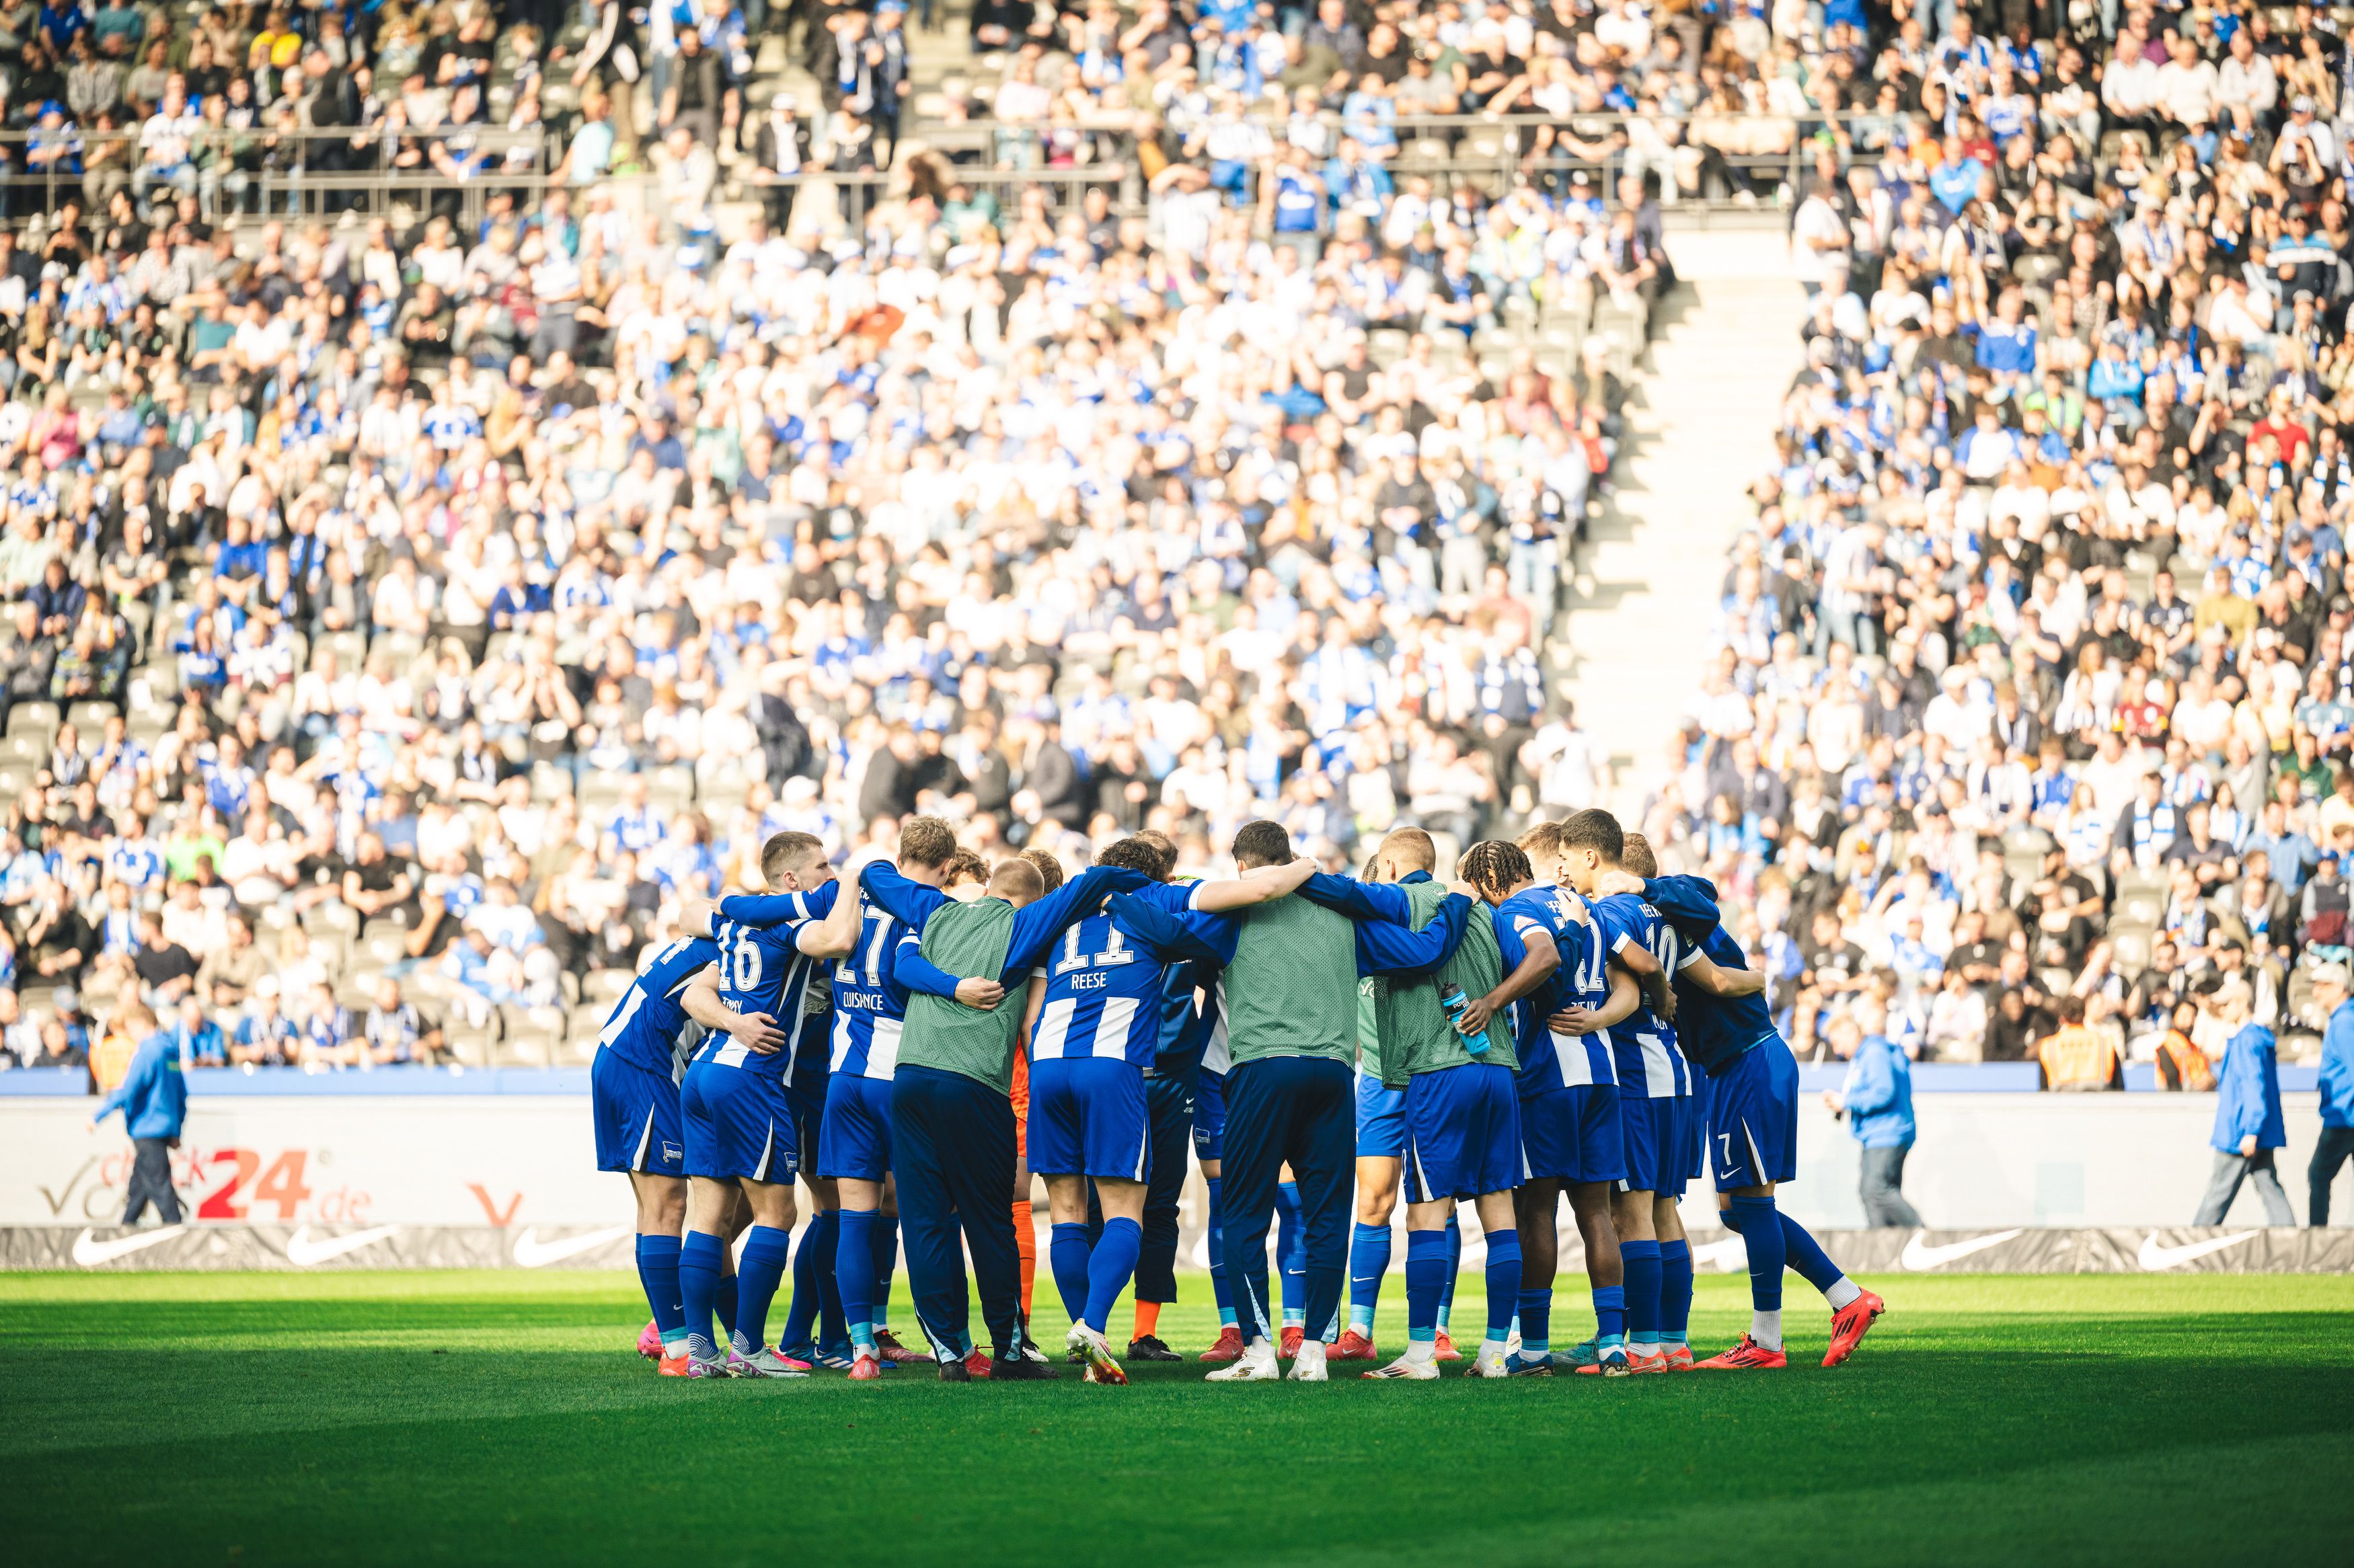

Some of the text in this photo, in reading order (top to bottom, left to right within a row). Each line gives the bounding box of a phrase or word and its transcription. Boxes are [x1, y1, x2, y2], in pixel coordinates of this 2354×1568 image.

[717, 919, 762, 992] 16
[1071, 972, 1107, 990] REESE
[843, 991, 884, 1011] CUISANCE
[1718, 1132, 1732, 1166] 7
